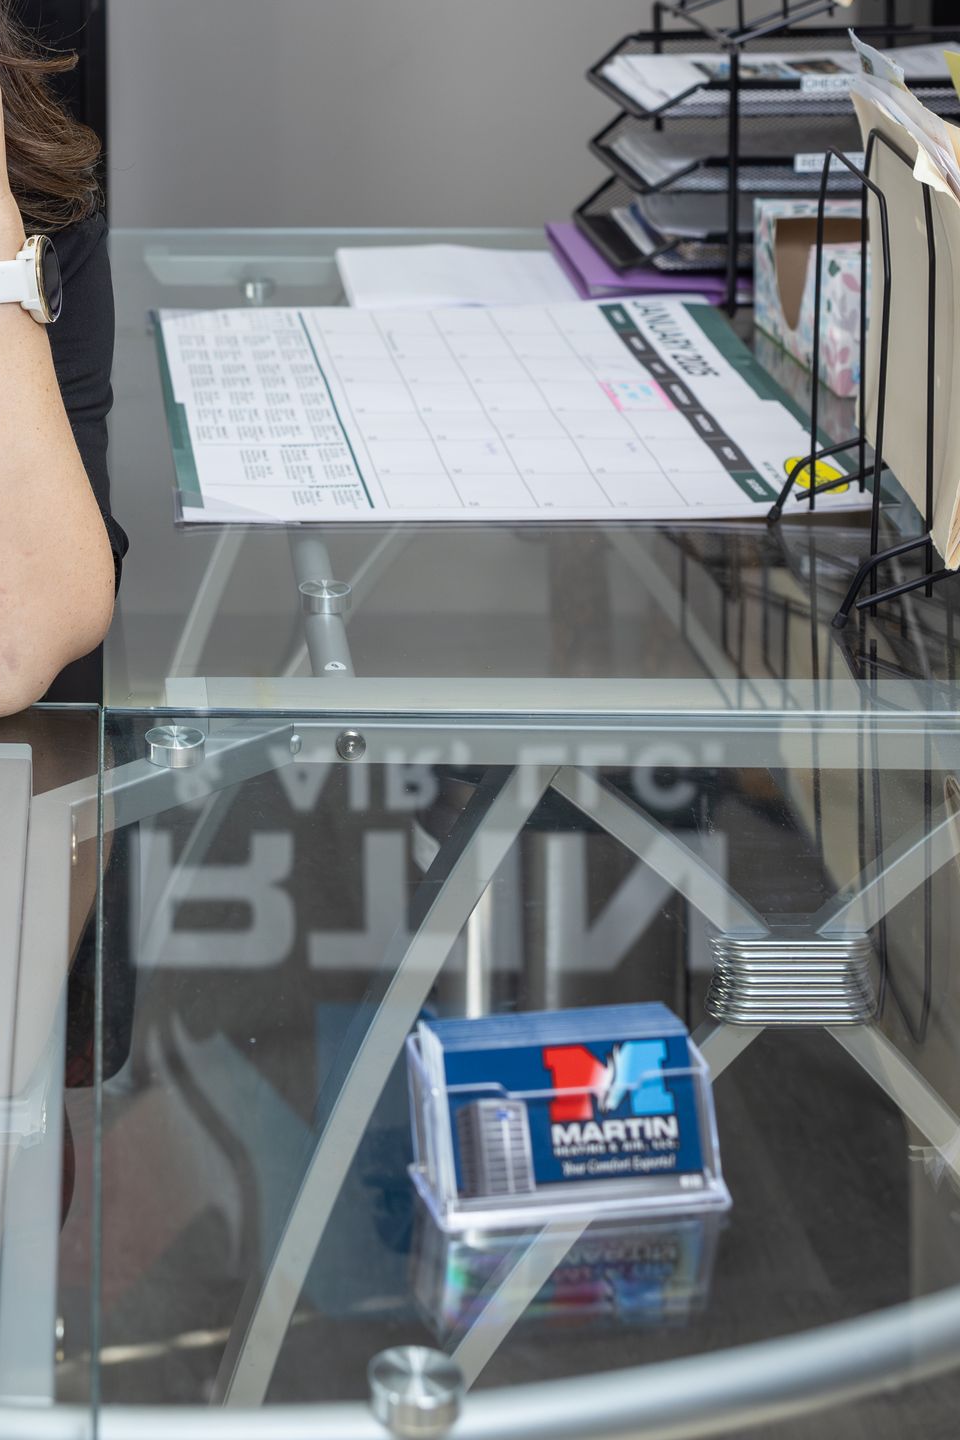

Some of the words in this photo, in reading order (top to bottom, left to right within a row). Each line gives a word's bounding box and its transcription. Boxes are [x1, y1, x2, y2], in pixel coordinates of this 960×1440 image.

[550, 1115, 679, 1146] MARTIN
[562, 1160, 586, 1177] Your
[587, 1157, 631, 1174] Comfort
